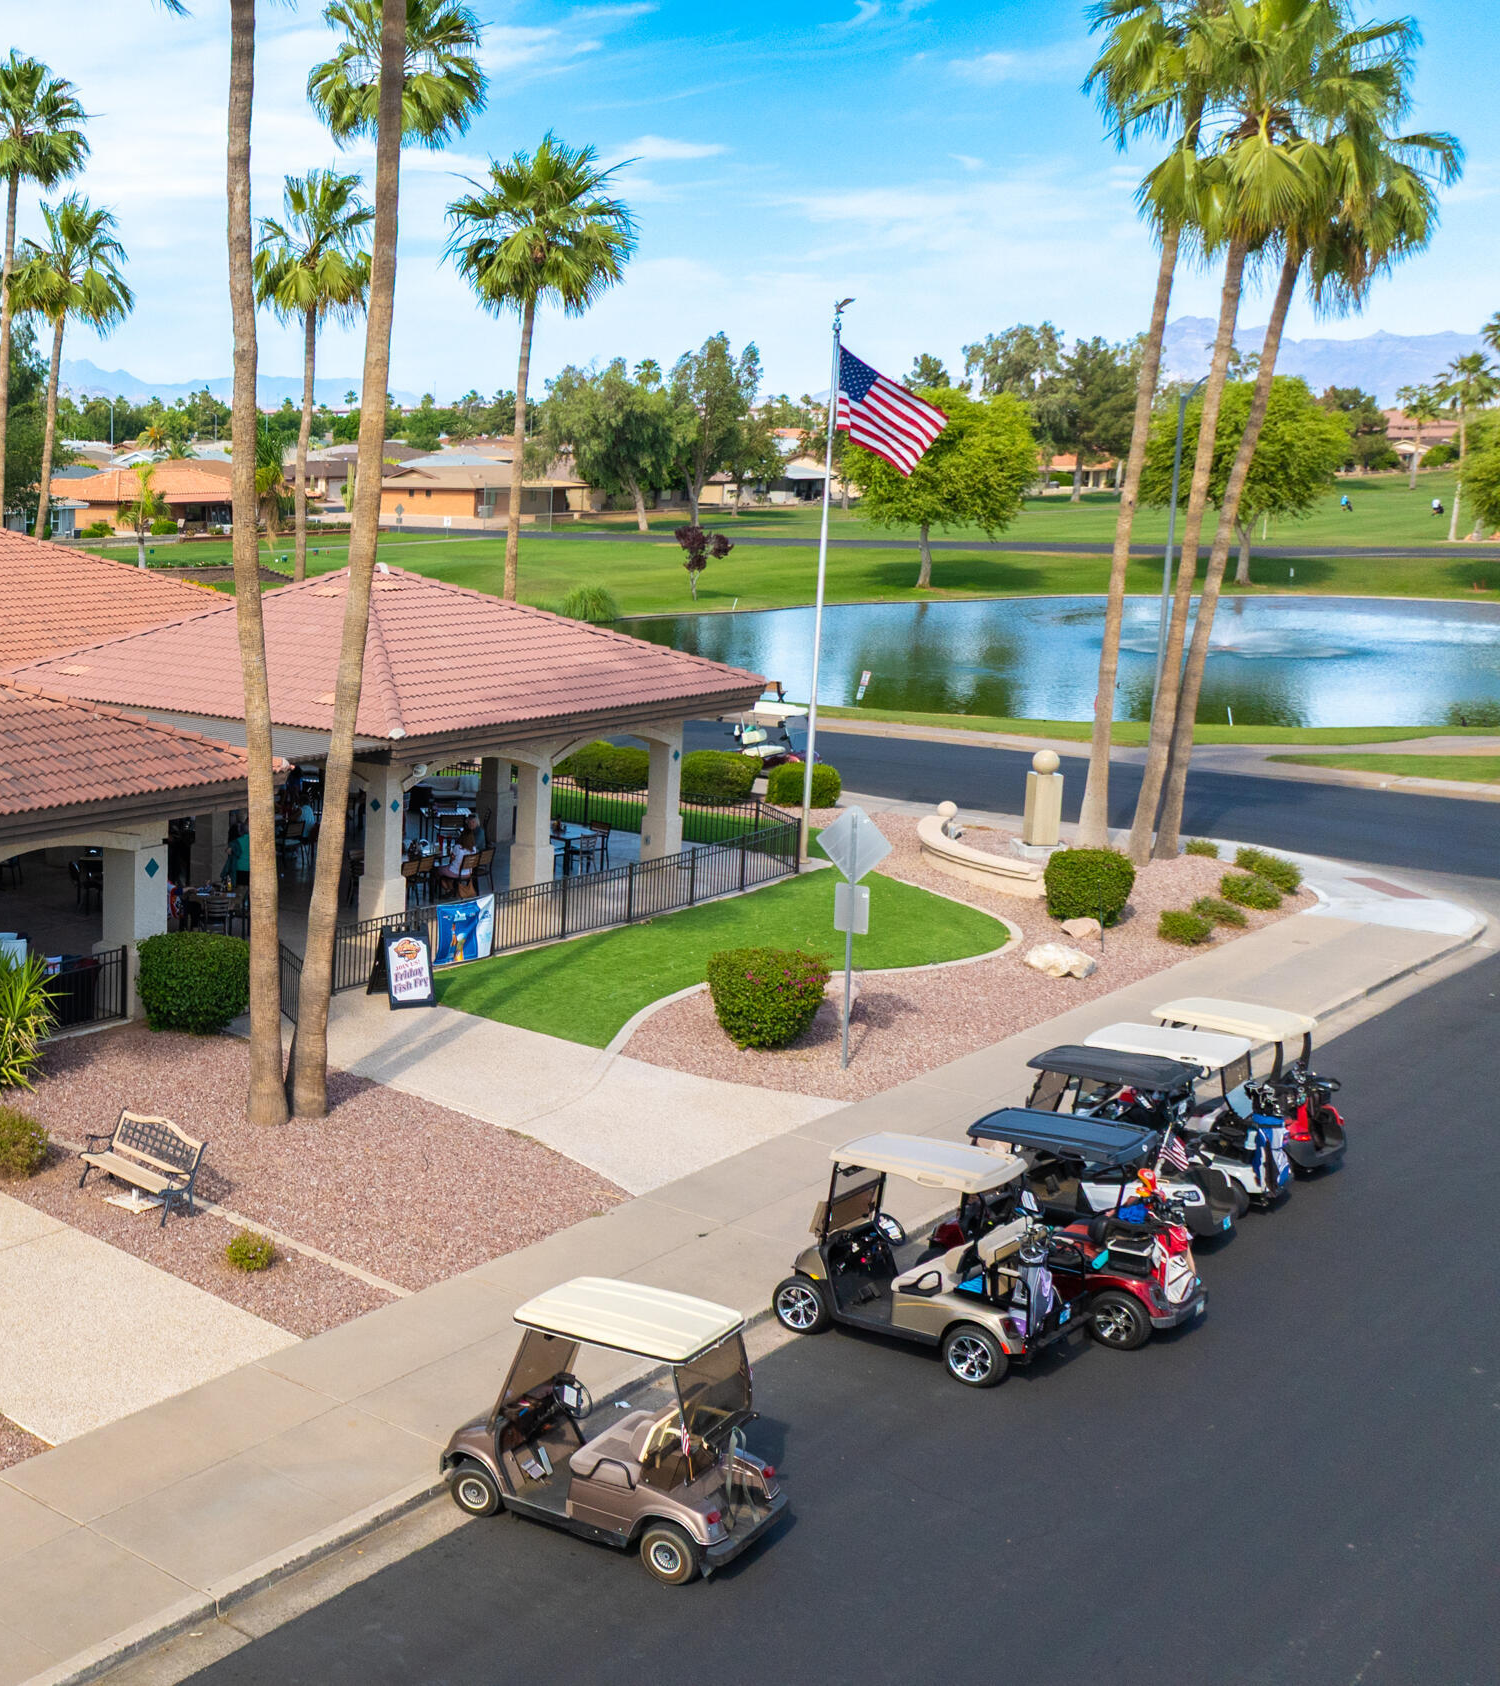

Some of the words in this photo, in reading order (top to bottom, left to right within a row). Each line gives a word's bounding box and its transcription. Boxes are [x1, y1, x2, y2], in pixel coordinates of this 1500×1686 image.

[394, 967, 423, 982] Friday
[393, 981, 412, 994] Fish
[414, 977, 428, 988] Fry
